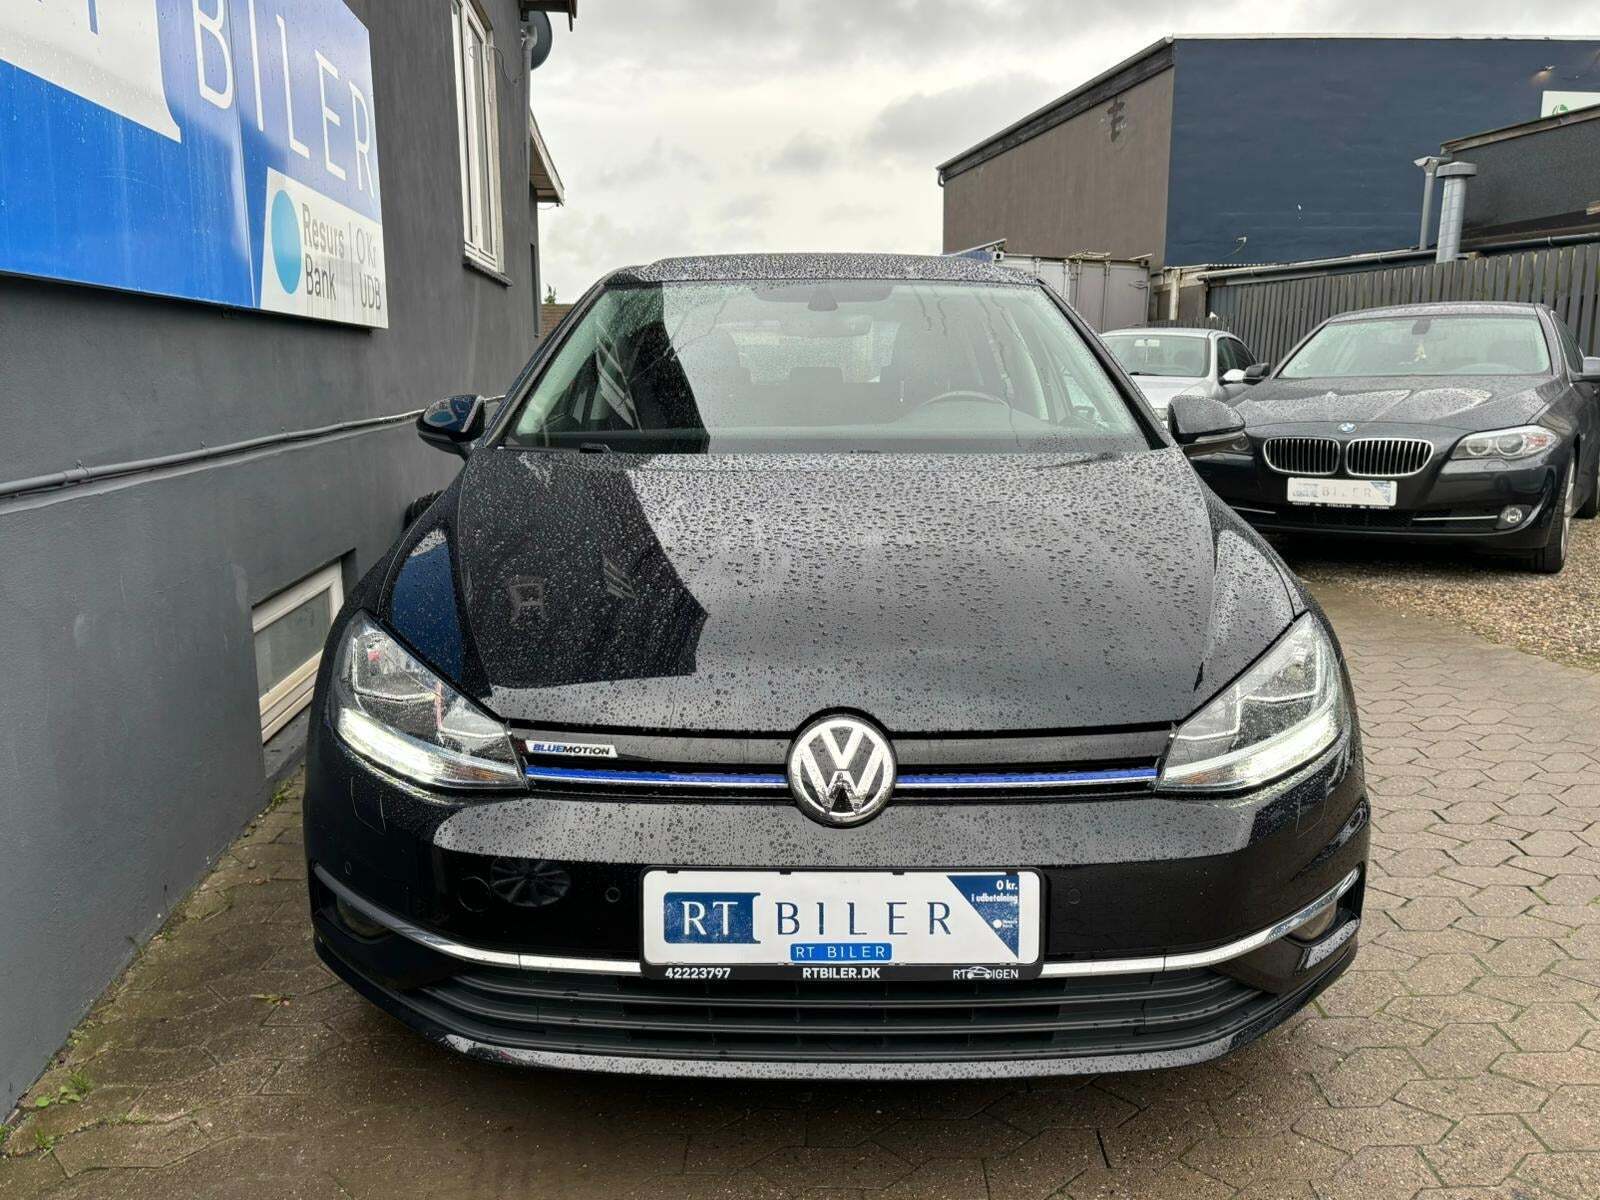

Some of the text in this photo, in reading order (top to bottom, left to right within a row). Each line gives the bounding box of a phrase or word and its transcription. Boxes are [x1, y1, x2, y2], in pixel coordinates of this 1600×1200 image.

[191, 0, 375, 199] BILER
[302, 203, 345, 259] Resurs
[305, 253, 337, 300] Bank
[532, 743, 610, 755] BLUEMOTION
[1006, 879, 1018, 890] kr.
[681, 901, 951, 935] RT BILER
[795, 945, 885, 958] RT BILER
[665, 968, 731, 978] 42223797
[802, 967, 880, 979] RTBILER.DK
[953, 969, 1019, 979] RT IGEN
